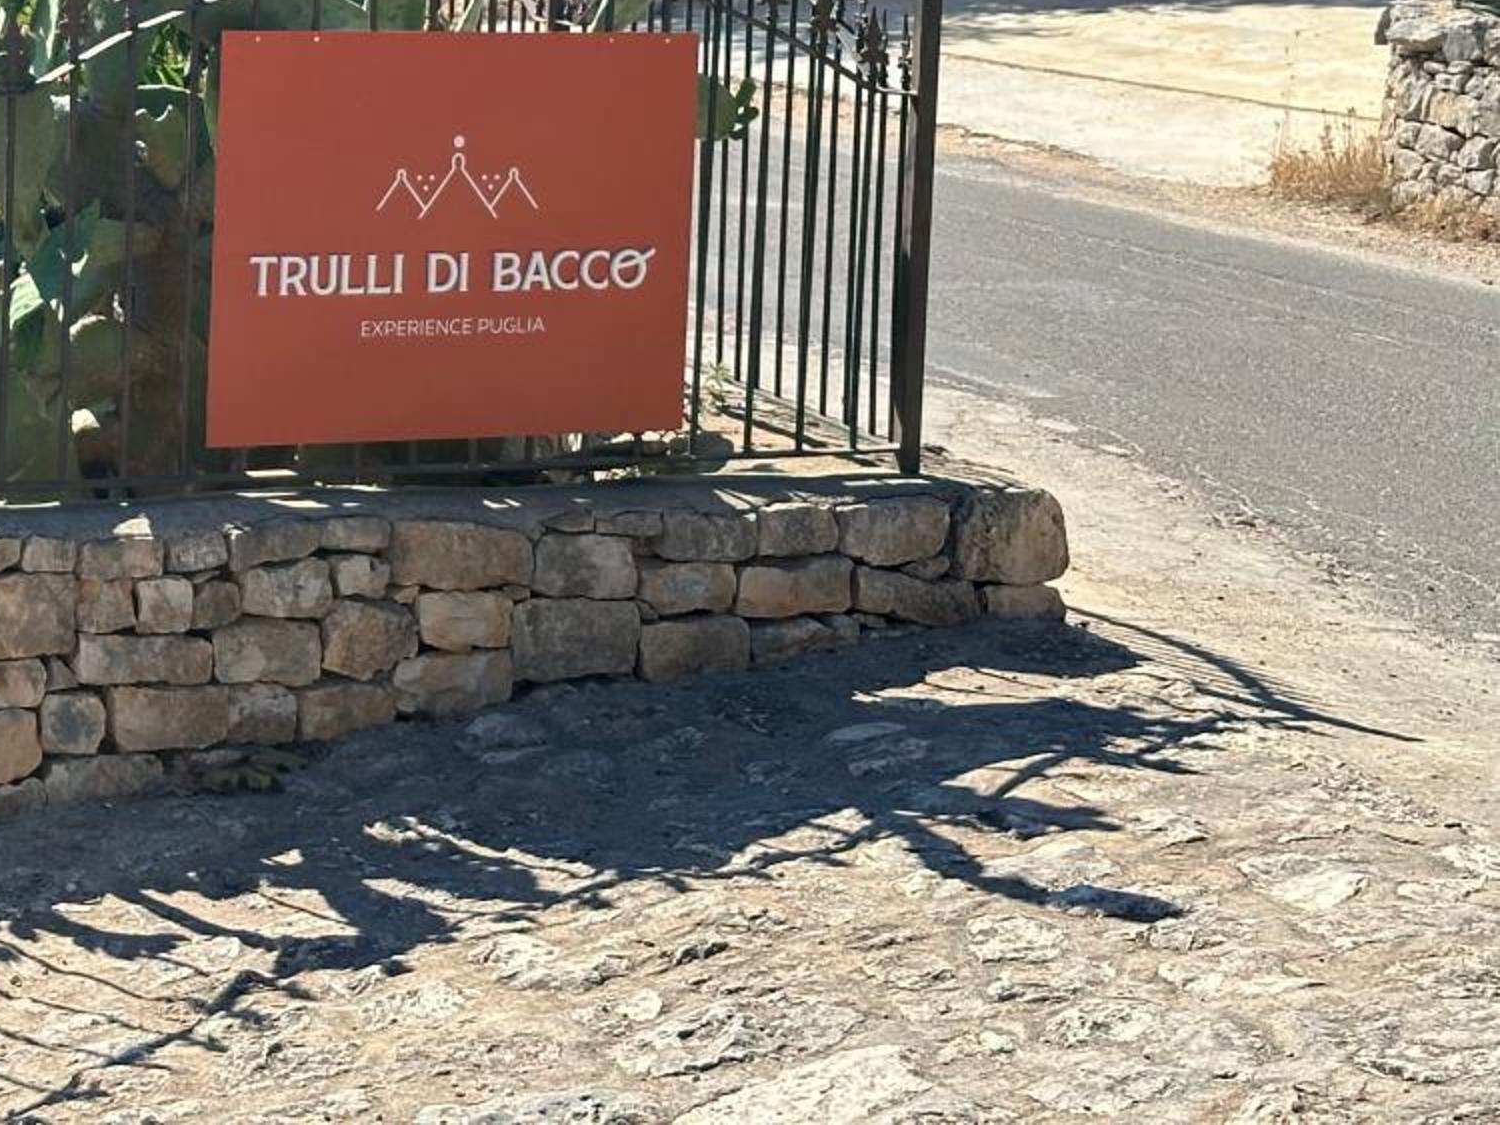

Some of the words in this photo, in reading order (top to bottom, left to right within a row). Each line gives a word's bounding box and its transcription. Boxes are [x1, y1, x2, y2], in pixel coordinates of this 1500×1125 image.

[250, 253, 405, 298] TRULLI
[427, 252, 470, 294] DI
[493, 247, 657, 292] BACCO
[361, 317, 472, 338] EXPERIENCE
[477, 316, 546, 335] PUGLIA
